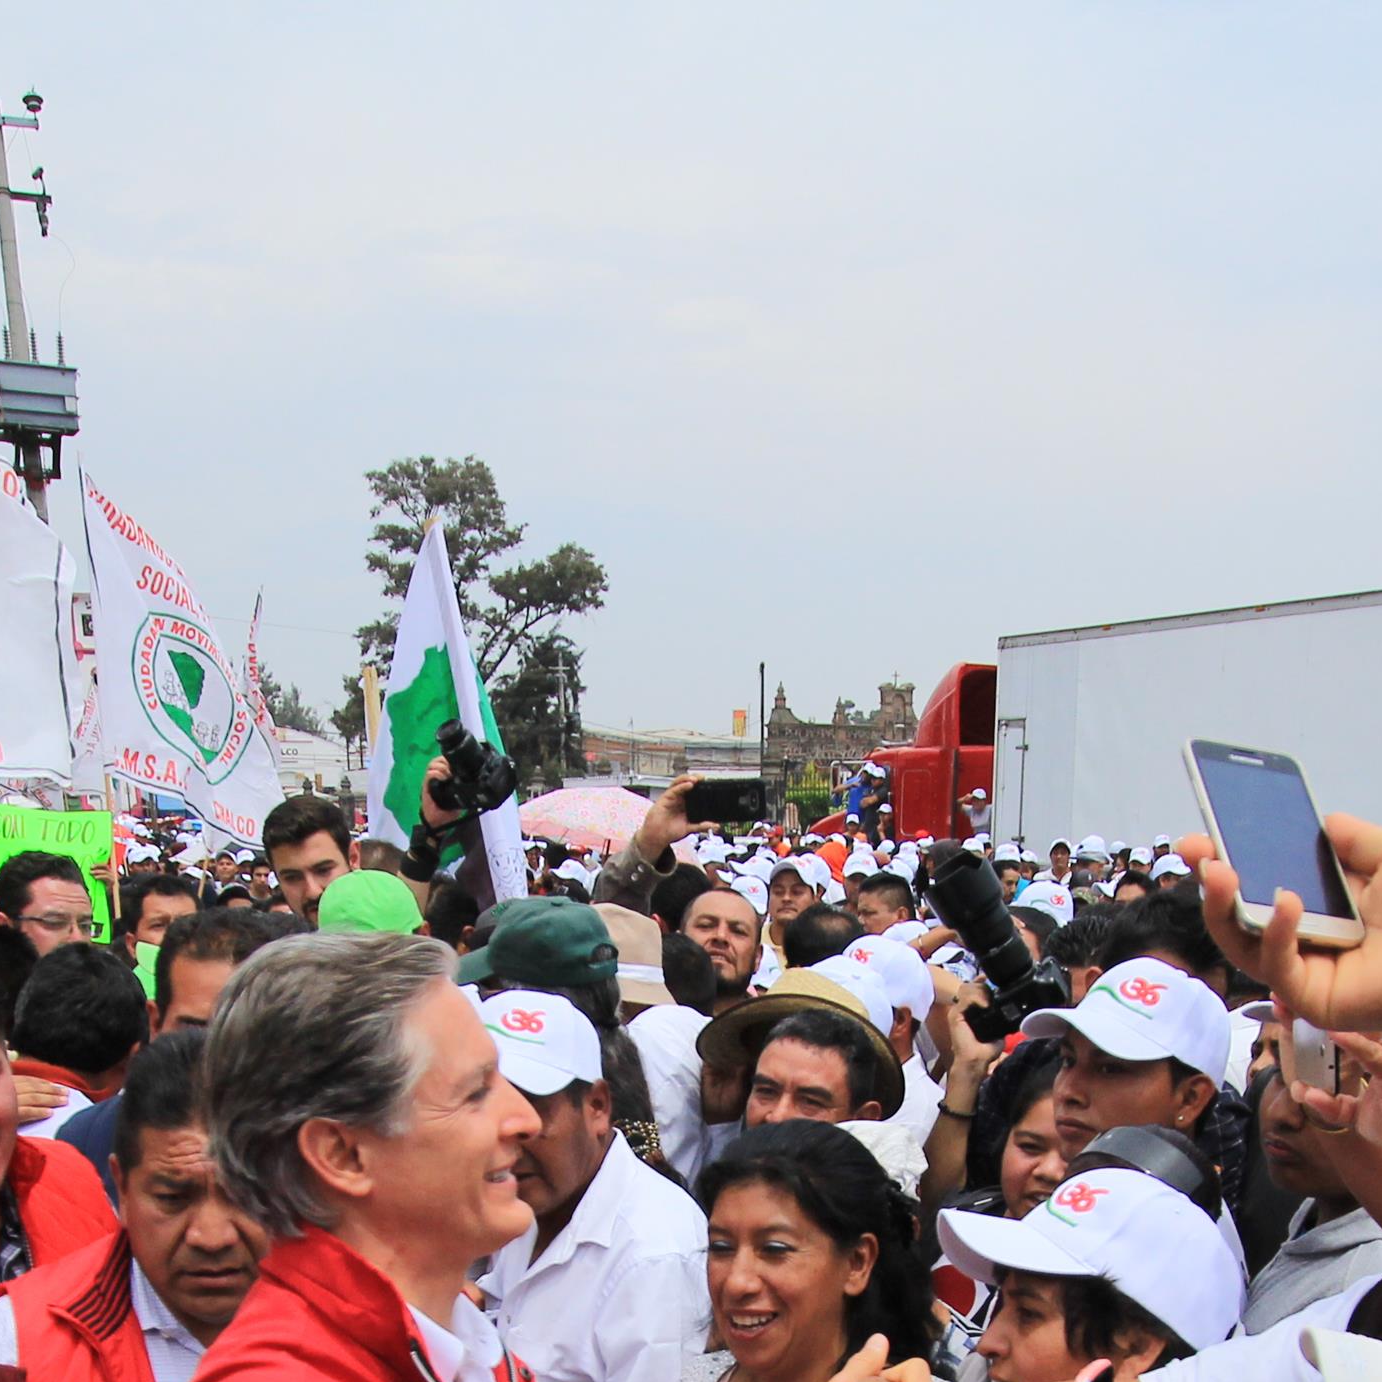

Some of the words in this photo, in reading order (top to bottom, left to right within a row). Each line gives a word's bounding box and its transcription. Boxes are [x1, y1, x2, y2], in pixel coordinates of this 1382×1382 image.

[136, 564, 201, 620] SOCIAL
[220, 710, 248, 767] SOCIAL
[39, 817, 96, 844] TODO
[1119, 977, 1168, 1007] 36
[500, 1008, 547, 1033] 36
